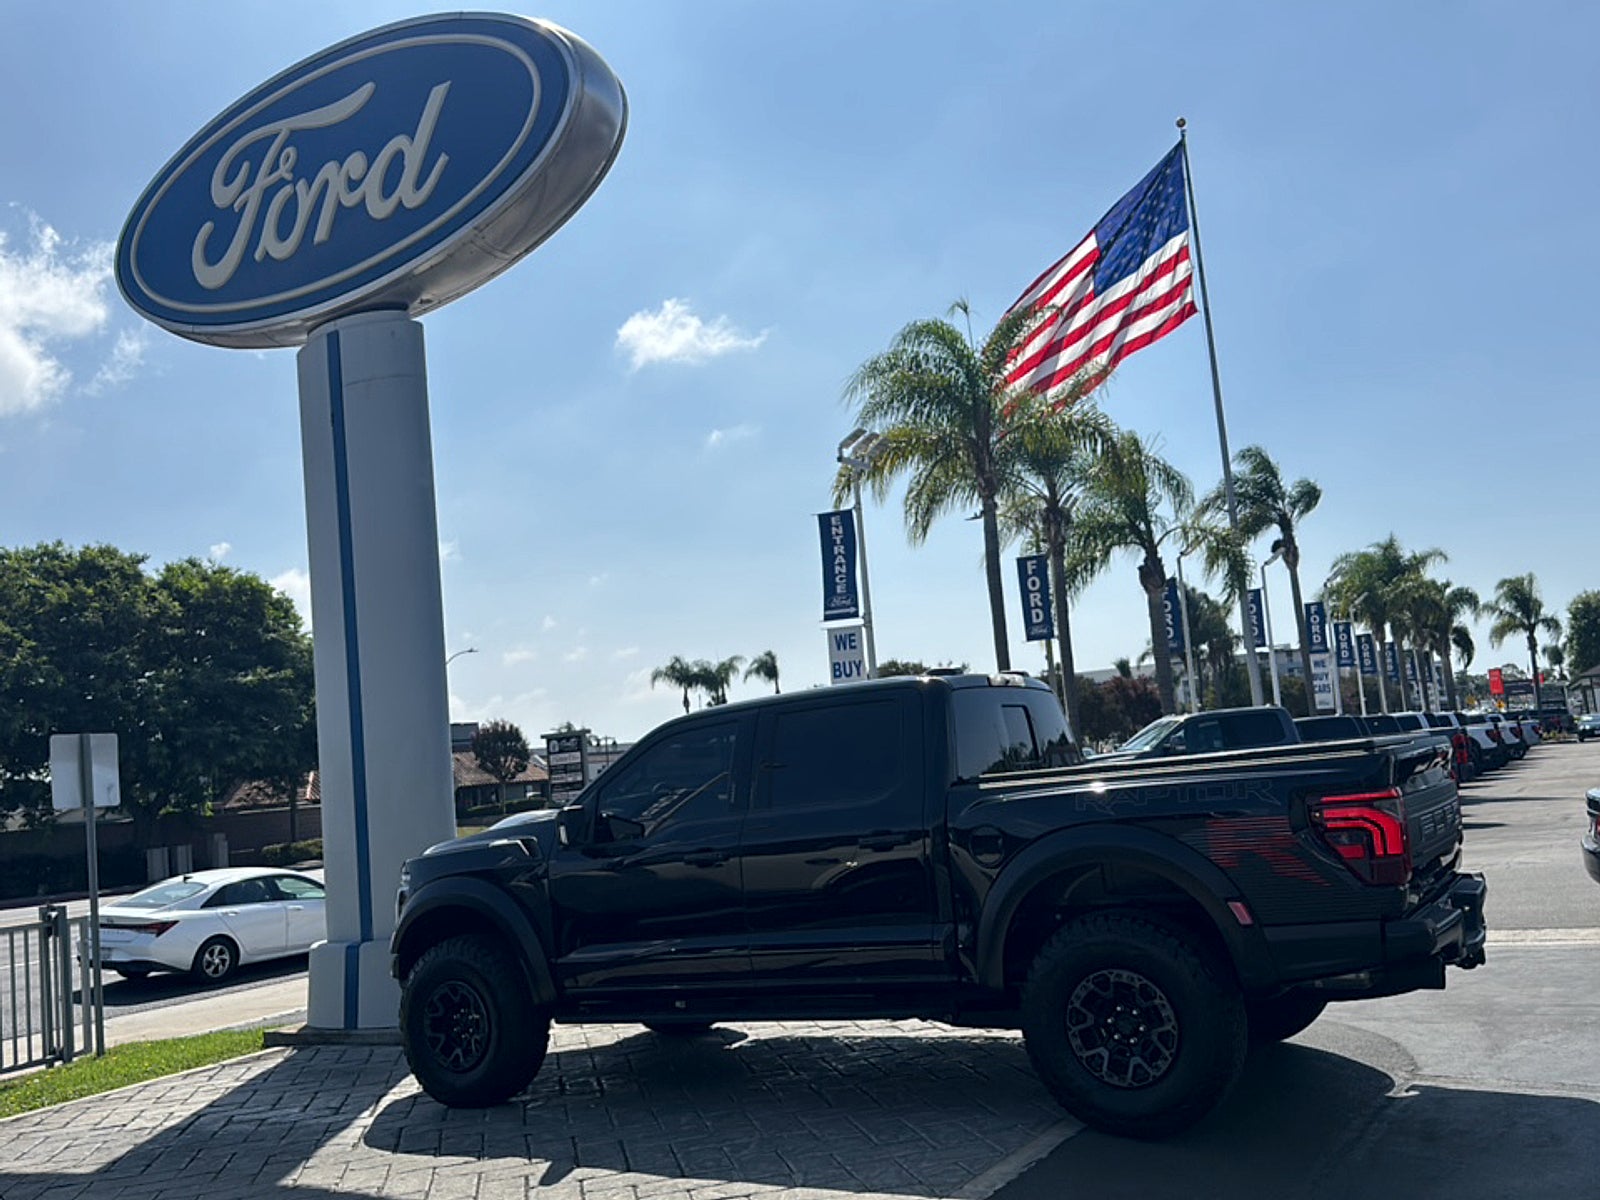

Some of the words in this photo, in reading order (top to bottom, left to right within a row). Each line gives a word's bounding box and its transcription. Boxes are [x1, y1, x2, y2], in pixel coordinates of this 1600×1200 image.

[191, 81, 452, 290] Ford
[831, 515, 847, 594] ENTRANCE
[1026, 560, 1044, 624] FORD
[834, 633, 857, 651] WE
[1310, 605, 1321, 643] FORD
[1338, 625, 1349, 658] FORD
[833, 660, 862, 679] BUY
[1074, 778, 1282, 816] RAPTOR
